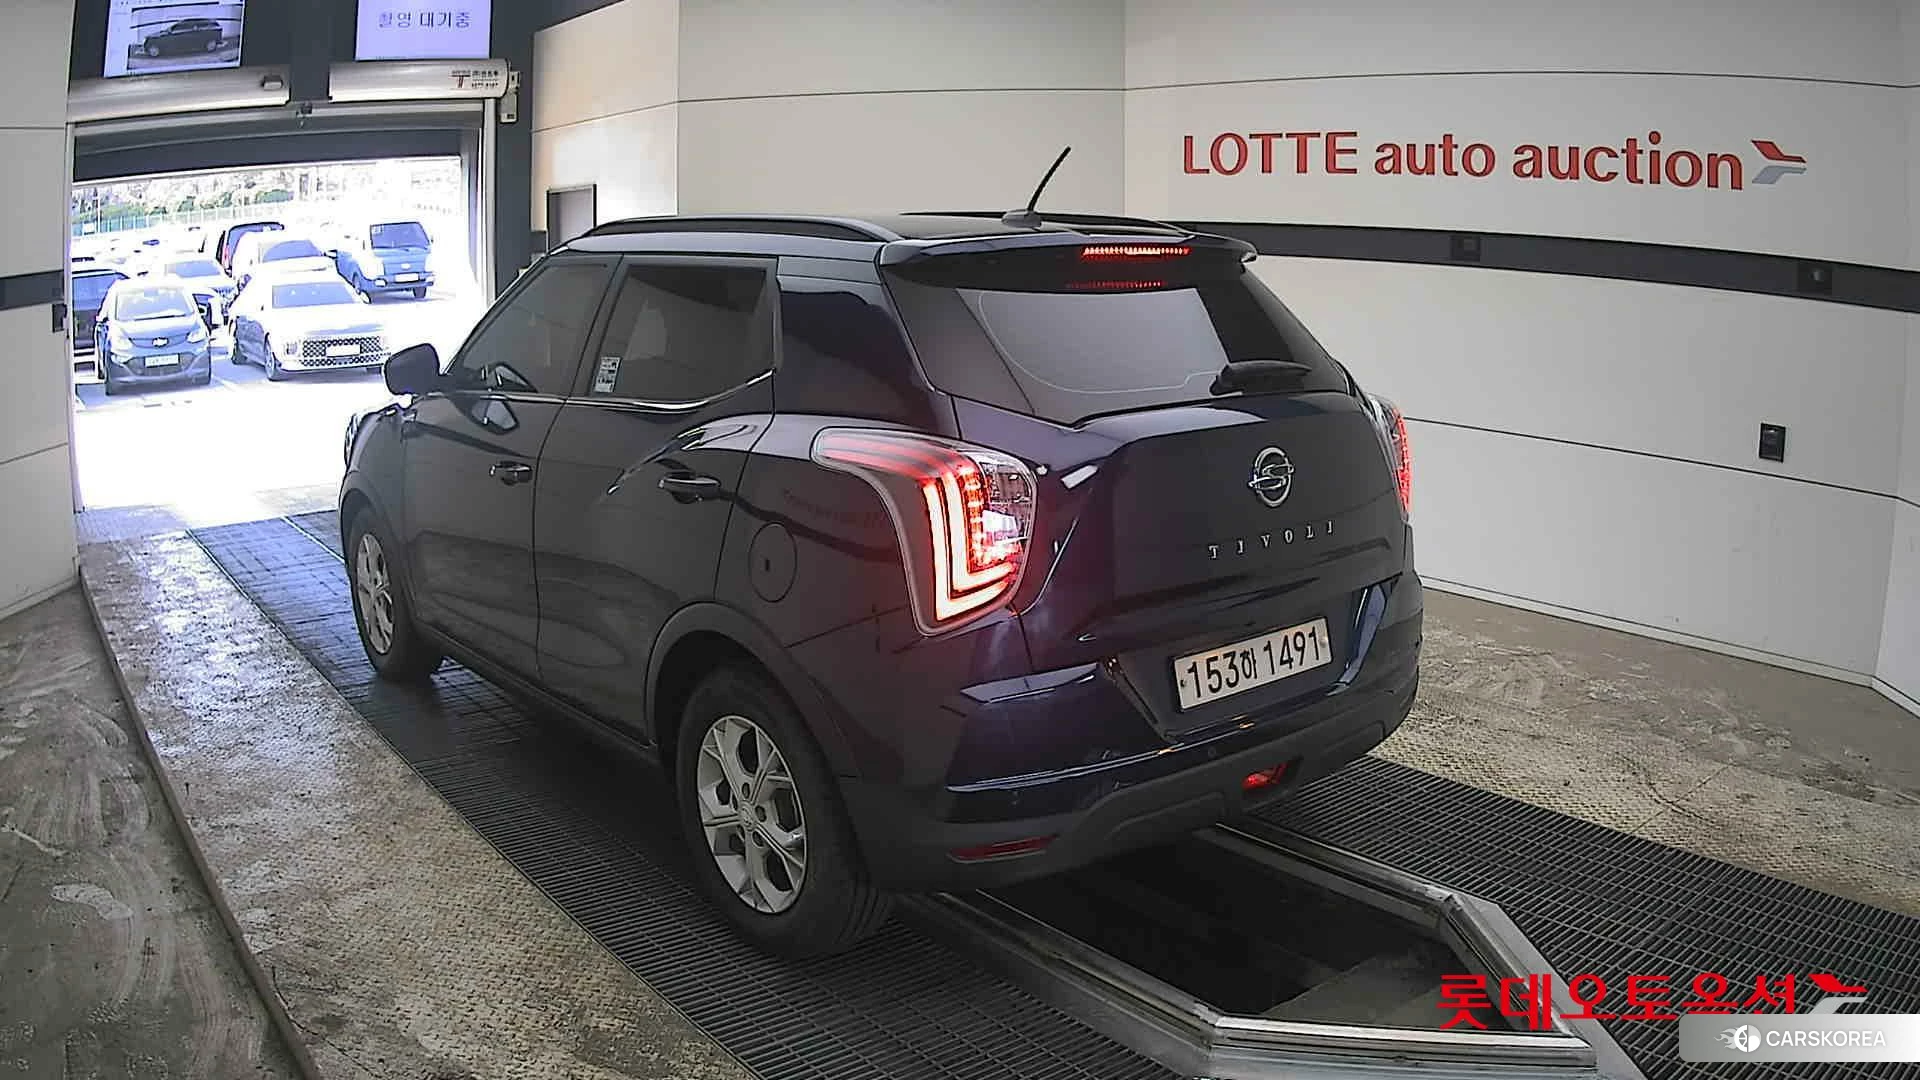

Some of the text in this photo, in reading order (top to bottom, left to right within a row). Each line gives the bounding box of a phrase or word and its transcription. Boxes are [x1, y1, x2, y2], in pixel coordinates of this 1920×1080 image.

[419, 11, 471, 28] 대기중
[1183, 130, 1743, 191] LOTTE auto auction
[1208, 520, 1335, 560] TIVOLI
[1263, 626, 1320, 675] 1491
